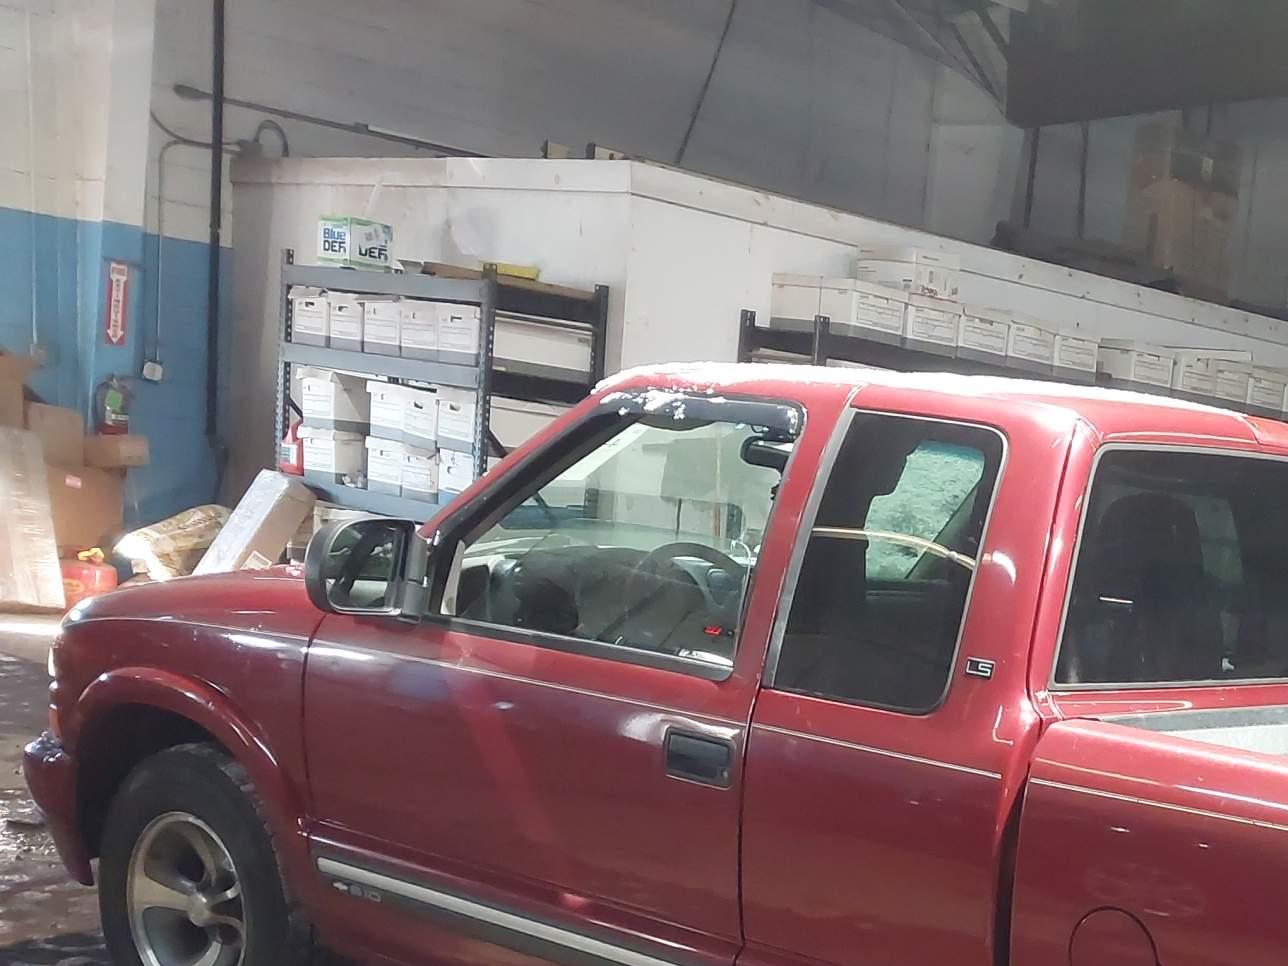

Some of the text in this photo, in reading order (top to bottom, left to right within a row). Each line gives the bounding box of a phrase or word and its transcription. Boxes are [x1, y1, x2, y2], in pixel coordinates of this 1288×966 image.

[323, 227, 346, 240] Blue
[323, 239, 347, 253] DEF
[966, 660, 993, 677] LS
